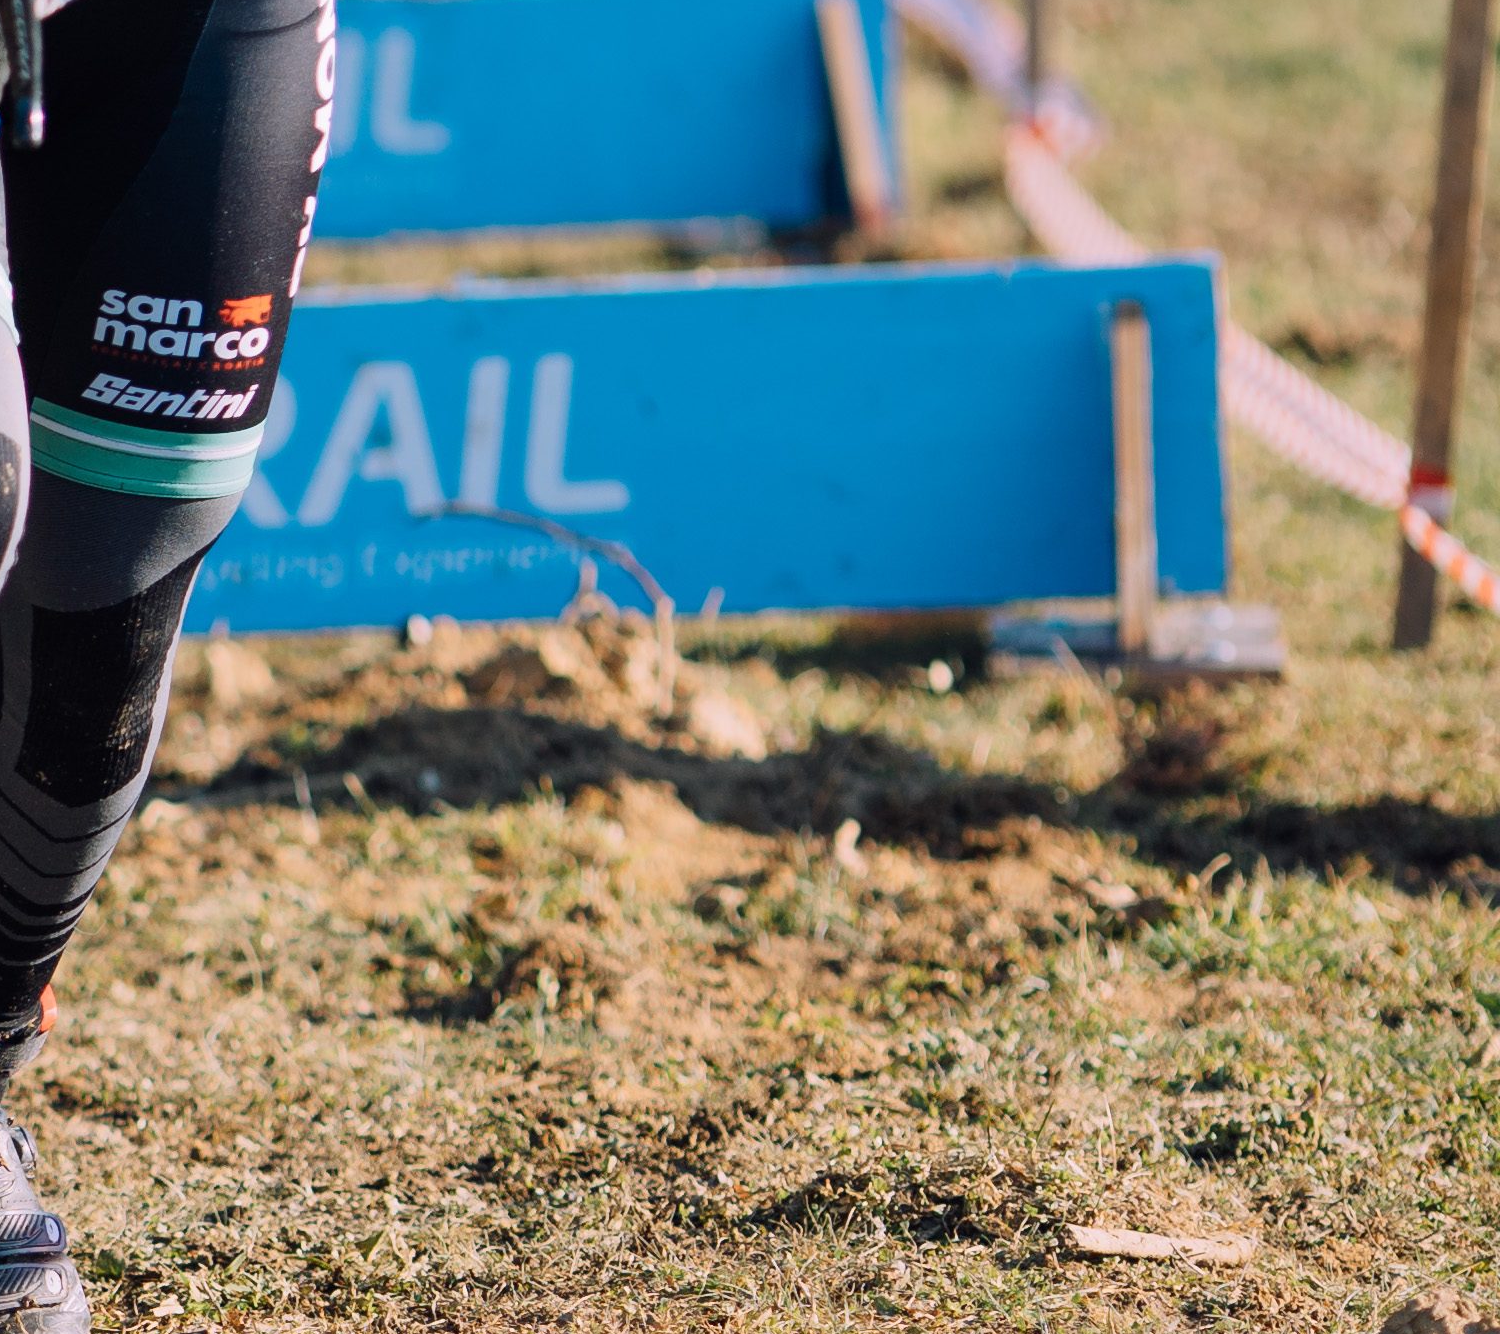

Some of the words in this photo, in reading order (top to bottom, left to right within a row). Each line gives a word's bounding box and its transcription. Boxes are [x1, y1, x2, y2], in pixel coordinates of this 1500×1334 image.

[100, 289, 204, 327] san
[93, 317, 270, 360] marco
[80, 372, 260, 419] Santini
